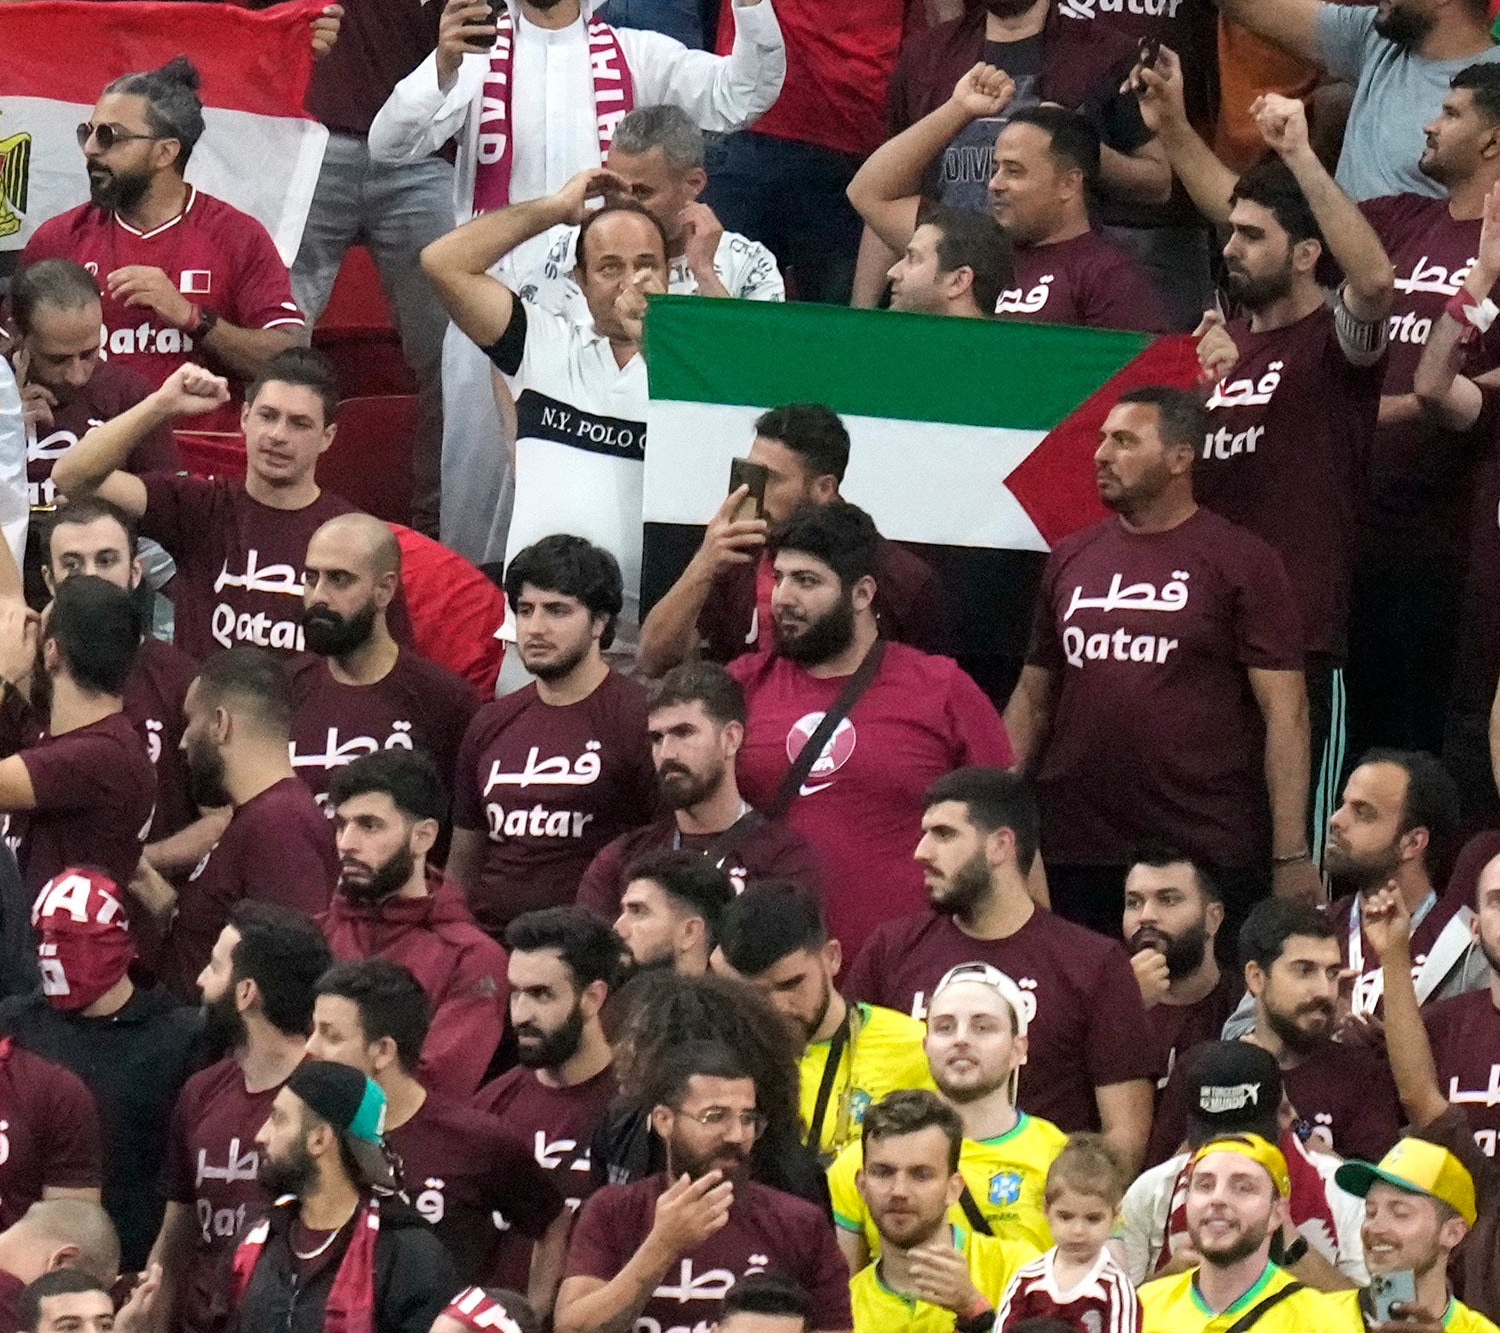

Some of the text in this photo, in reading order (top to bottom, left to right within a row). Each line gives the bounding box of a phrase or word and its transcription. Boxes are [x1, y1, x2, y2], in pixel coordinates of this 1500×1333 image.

[1394, 256, 1482, 295] قط
[577, 420, 634, 449] POLO
[1064, 571, 1189, 620] قطر
[1064, 627, 1177, 667] Qatar
[484, 741, 601, 796] قطر
[487, 803, 591, 839] Qatar
[197, 1138, 258, 1184] طر
